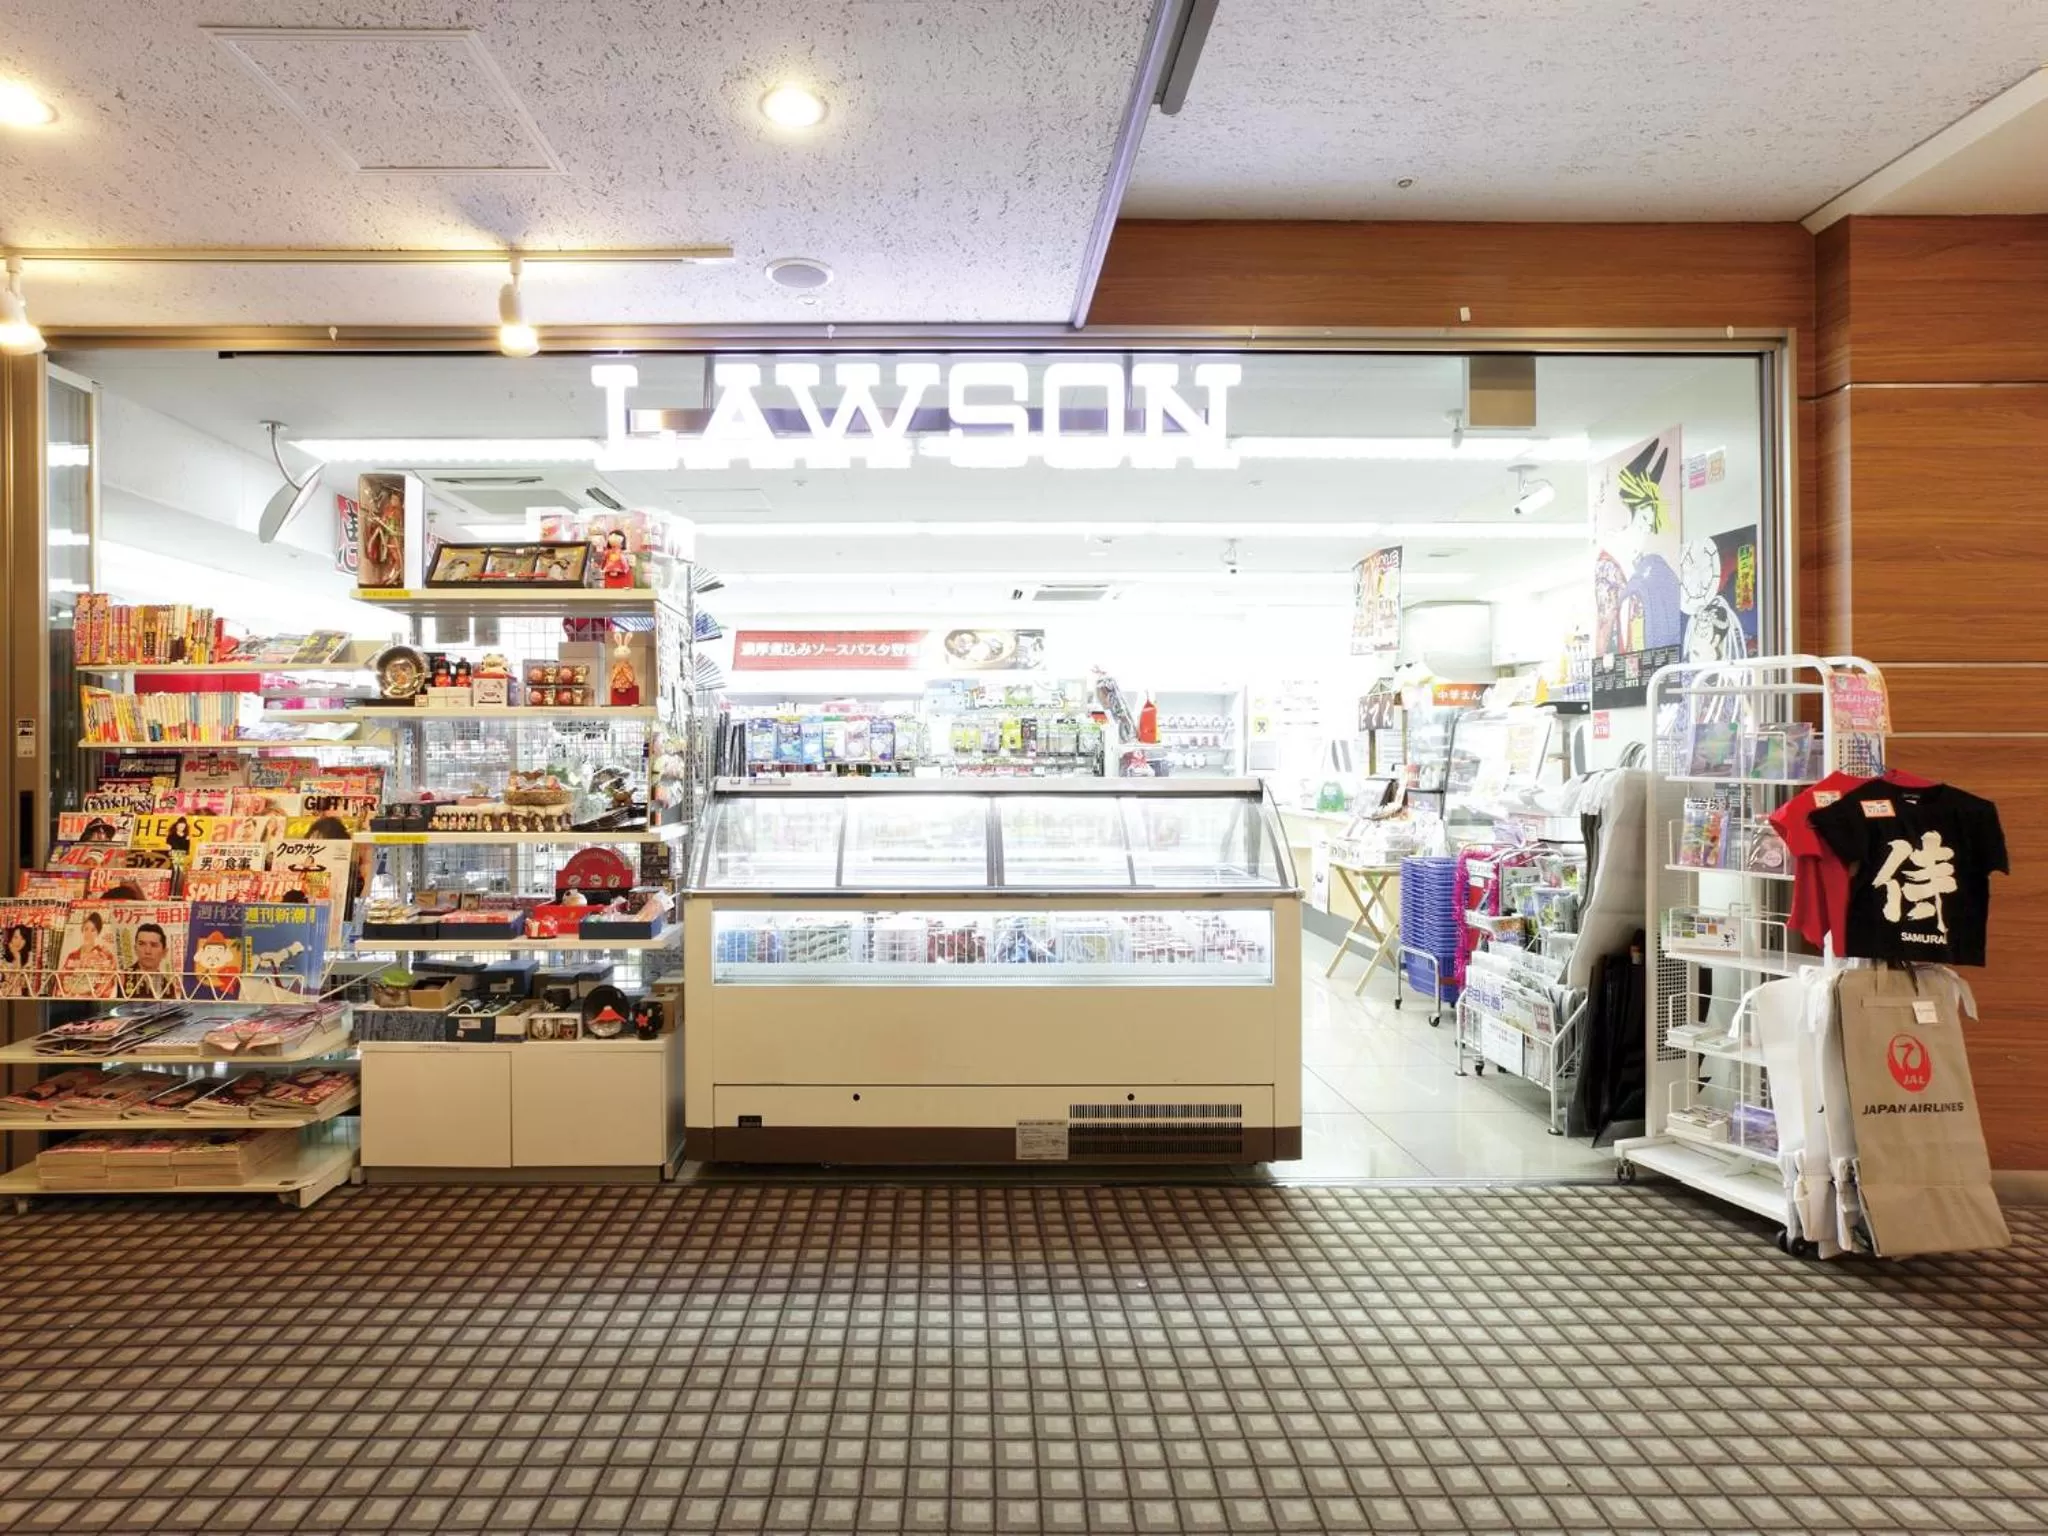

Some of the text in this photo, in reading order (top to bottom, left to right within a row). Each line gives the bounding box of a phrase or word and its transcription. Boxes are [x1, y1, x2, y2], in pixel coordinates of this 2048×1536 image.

[591, 362, 1241, 470] LAWSON
[136, 819, 205, 838] HES
[199, 857, 252, 871] 男の食事
[1873, 831, 1957, 934] 侍
[113, 908, 182, 924] サンデー毎日
[245, 907, 307, 924] 週刊新潮
[1903, 1074, 1926, 1085] JAL
[1862, 1101, 1964, 1116] JAPAN AIRLINES
